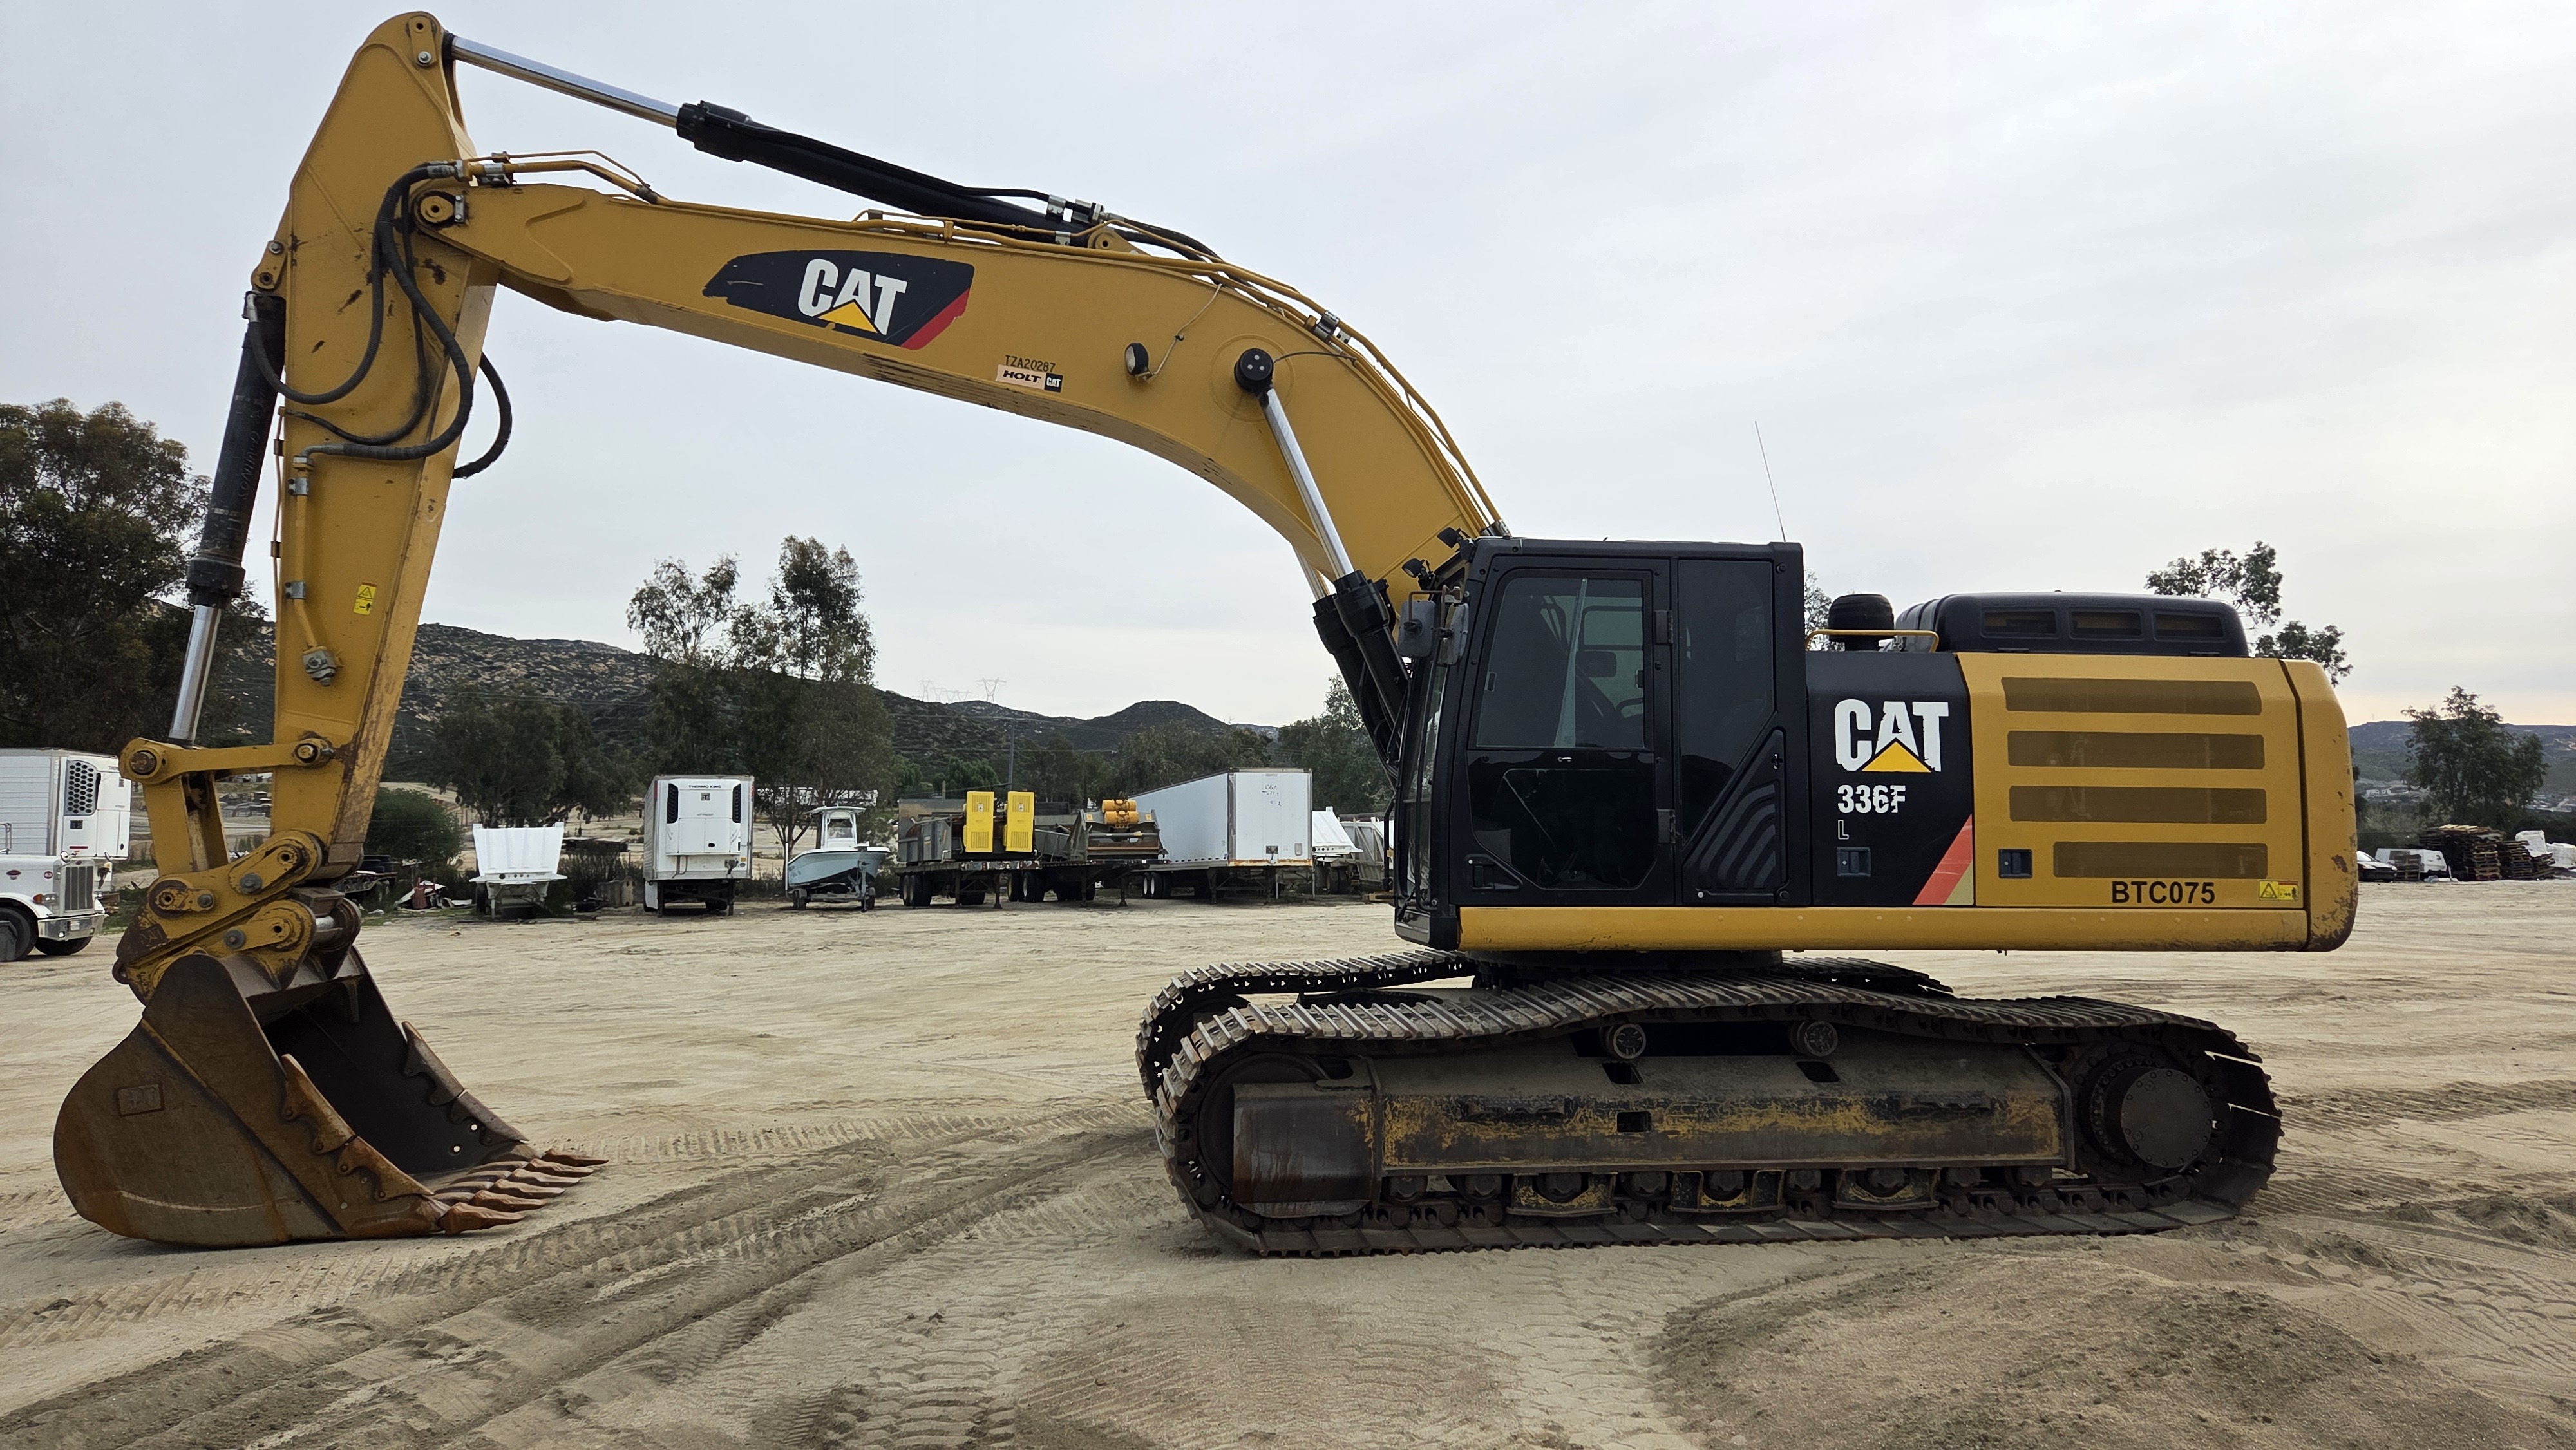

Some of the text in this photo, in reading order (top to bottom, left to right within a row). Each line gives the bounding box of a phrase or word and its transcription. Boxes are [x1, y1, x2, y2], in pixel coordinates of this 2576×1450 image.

[797, 259, 908, 335] CAT
[1005, 354, 1056, 373] TZA20287
[1003, 370, 1061, 388] HOLT CAT
[1834, 699, 1949, 773] CAT
[1837, 784, 1906, 813] 336F
[1837, 819, 1850, 840] L
[2111, 880, 2215, 904] BTC075
